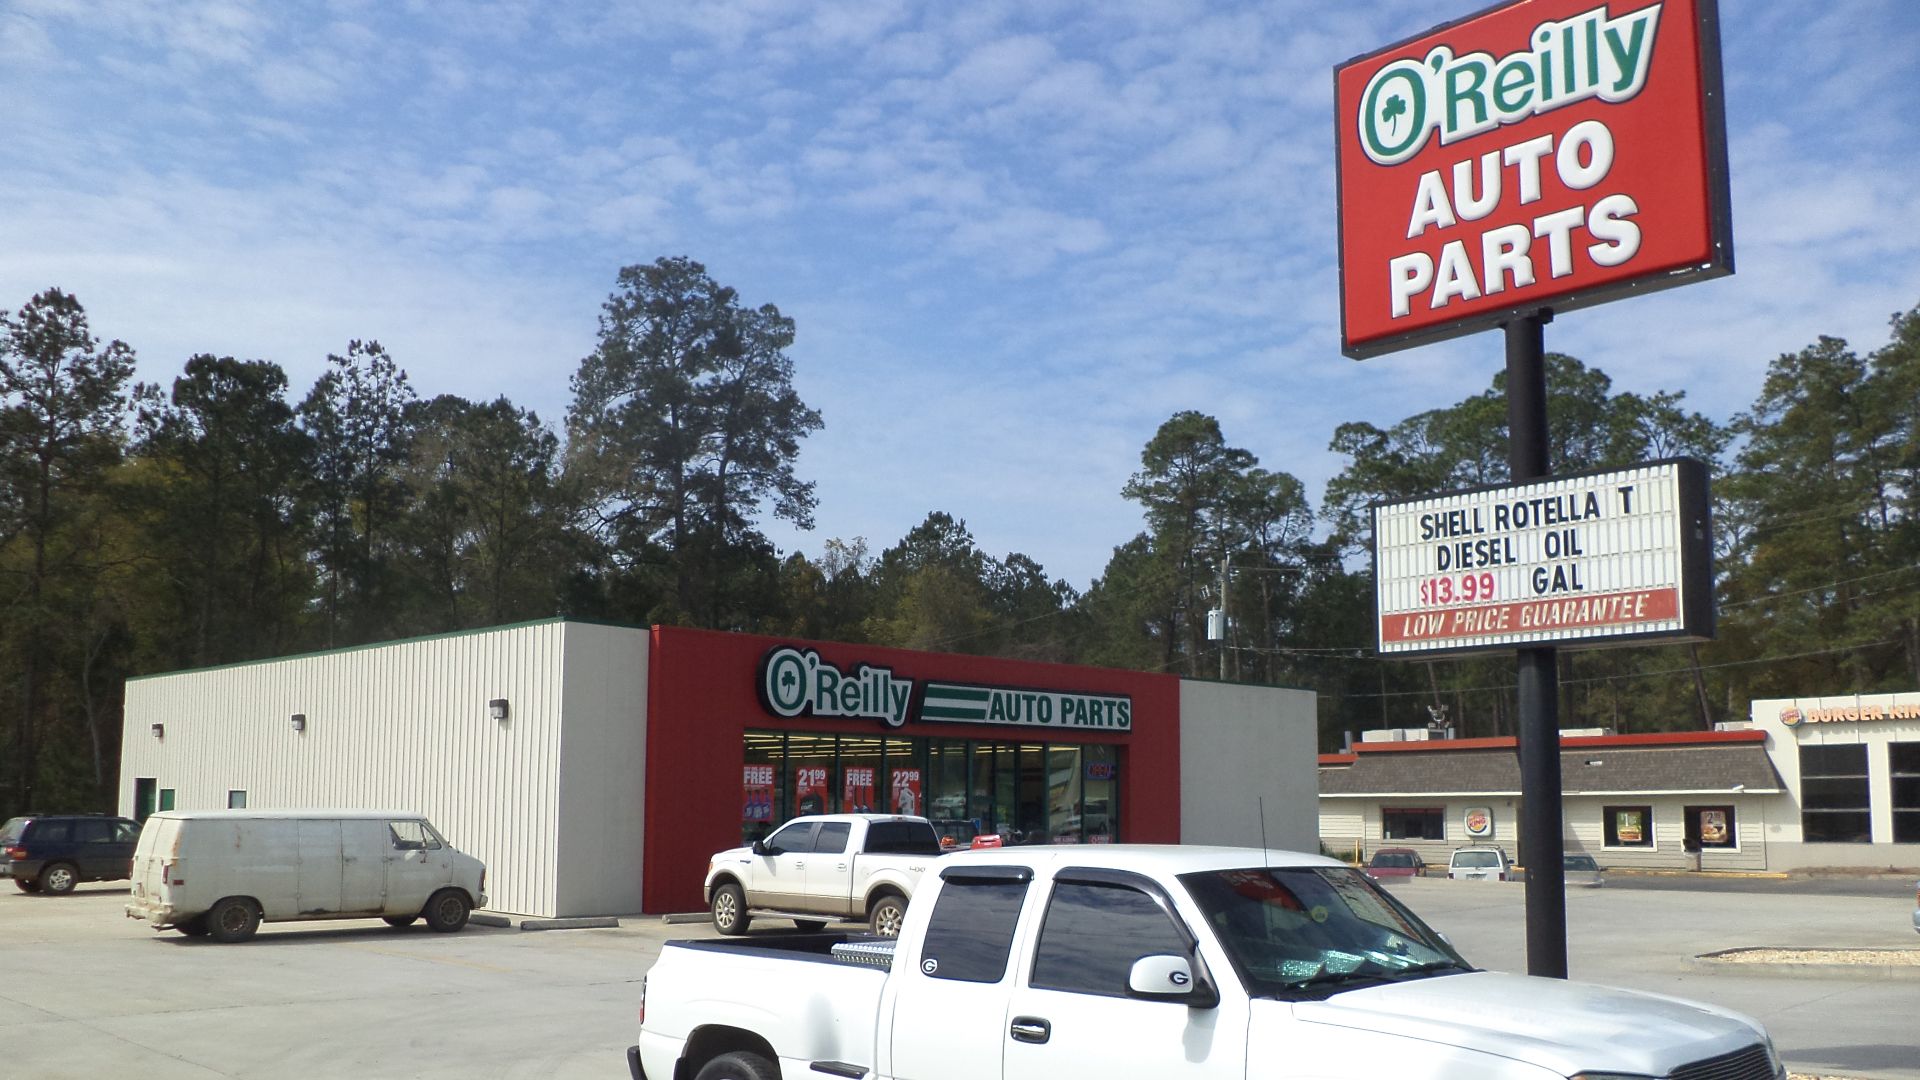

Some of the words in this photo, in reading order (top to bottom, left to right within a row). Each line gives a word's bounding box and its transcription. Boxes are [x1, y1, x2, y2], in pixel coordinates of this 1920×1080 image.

[1364, 14, 1648, 157] O'Reilly
[1407, 120, 1614, 238] AUTO
[1390, 194, 1641, 319] PARTS
[1420, 508, 1484, 541] SHELL
[1495, 491, 1600, 531] ROTELLA
[1618, 486, 1633, 514] T
[1437, 537, 1516, 571] DIESEL
[1544, 528, 1582, 559] OIL
[1420, 572, 1495, 605] $13.99
[1532, 563, 1583, 595] GAL
[1403, 613, 1444, 638] LOW
[1452, 607, 1510, 633] PRICE
[1520, 594, 1650, 626] GUARANTEE
[769, 652, 909, 724] O'Reilly
[989, 691, 1053, 724] AUTO
[1060, 696, 1130, 728] PARTS
[1807, 705, 1884, 723] BURGER
